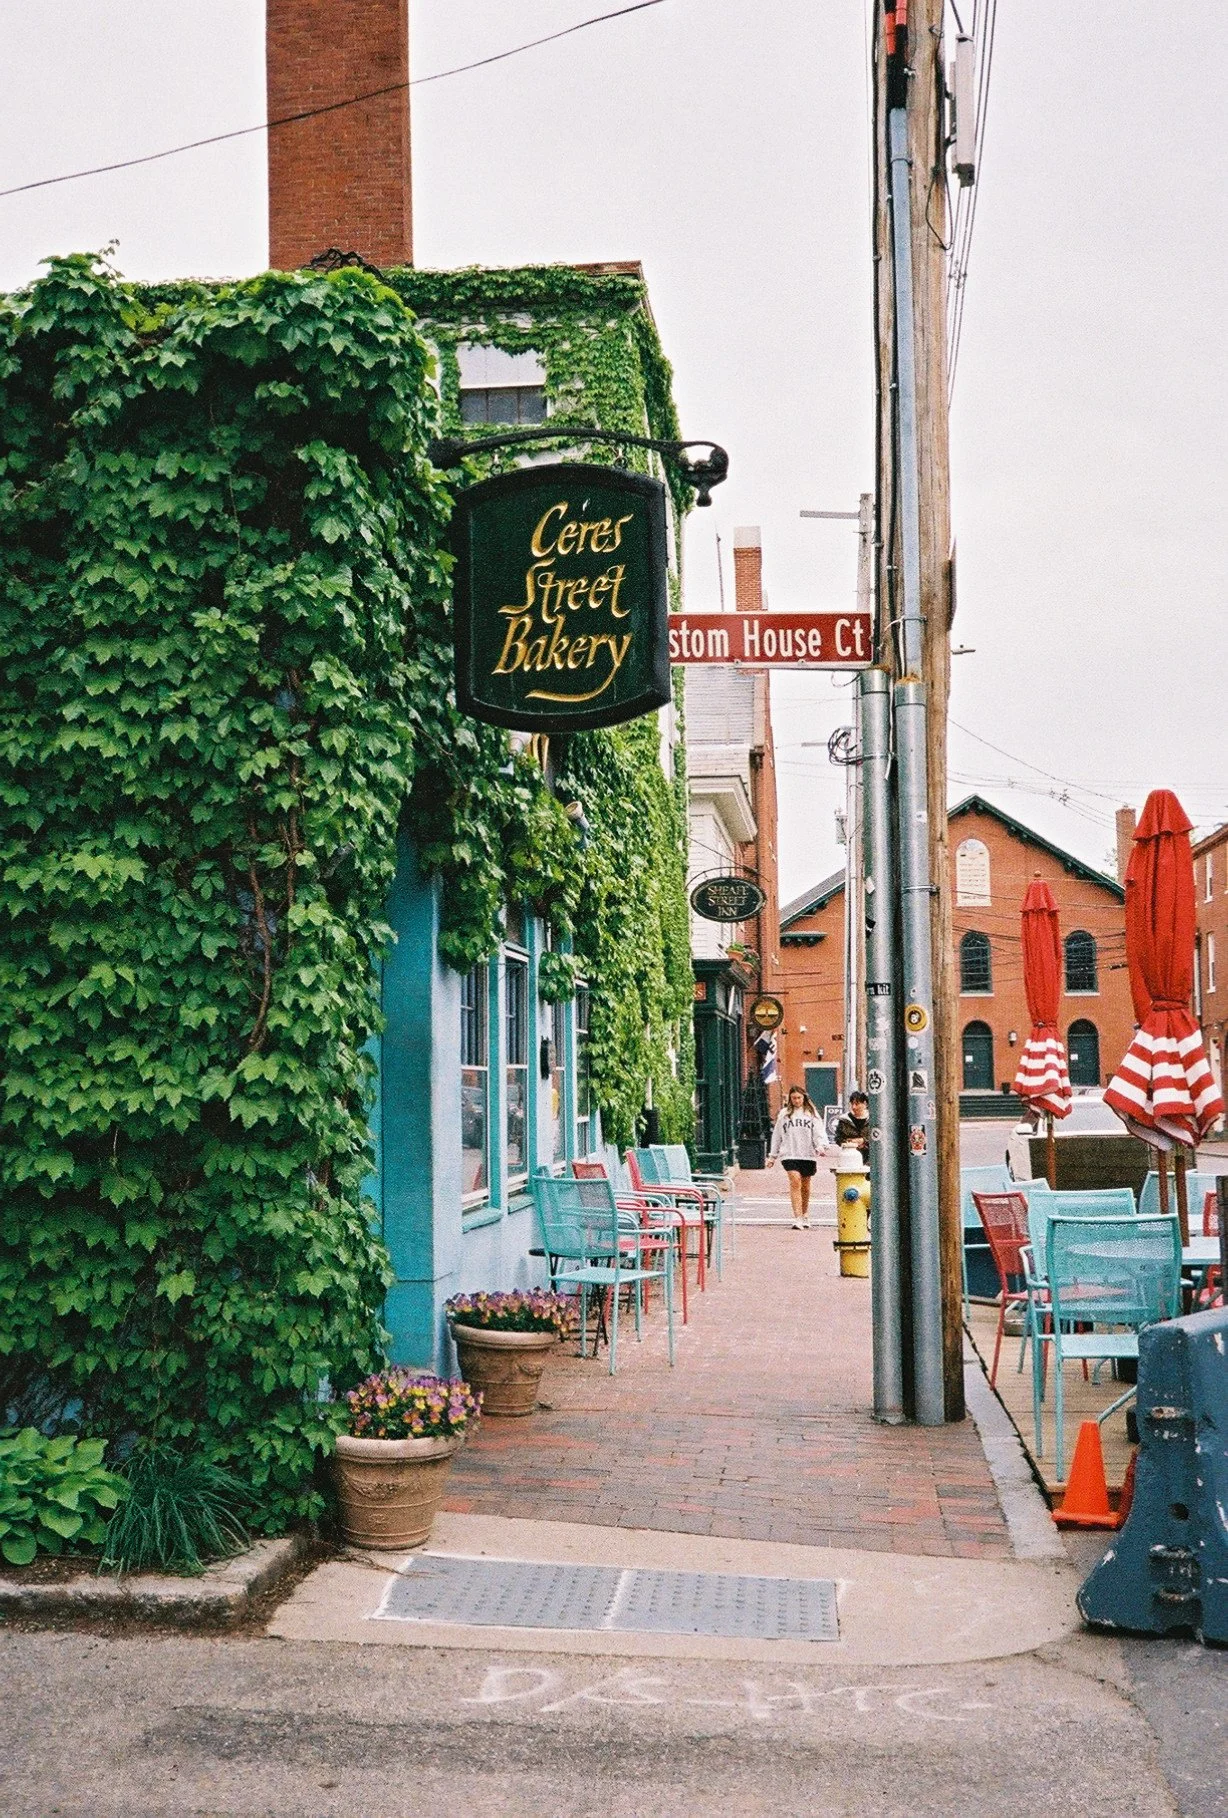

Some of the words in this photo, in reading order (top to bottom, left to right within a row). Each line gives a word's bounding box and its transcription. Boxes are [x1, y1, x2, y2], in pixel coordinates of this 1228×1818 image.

[531, 501, 634, 557] Ceres
[498, 558, 632, 624] Street
[491, 614, 633, 702] Bakery
[669, 620, 729, 658] stom
[743, 619, 822, 658] House
[834, 618, 865, 657] Ct
[707, 896, 748, 907] STREET
[718, 906, 738, 917] INN
